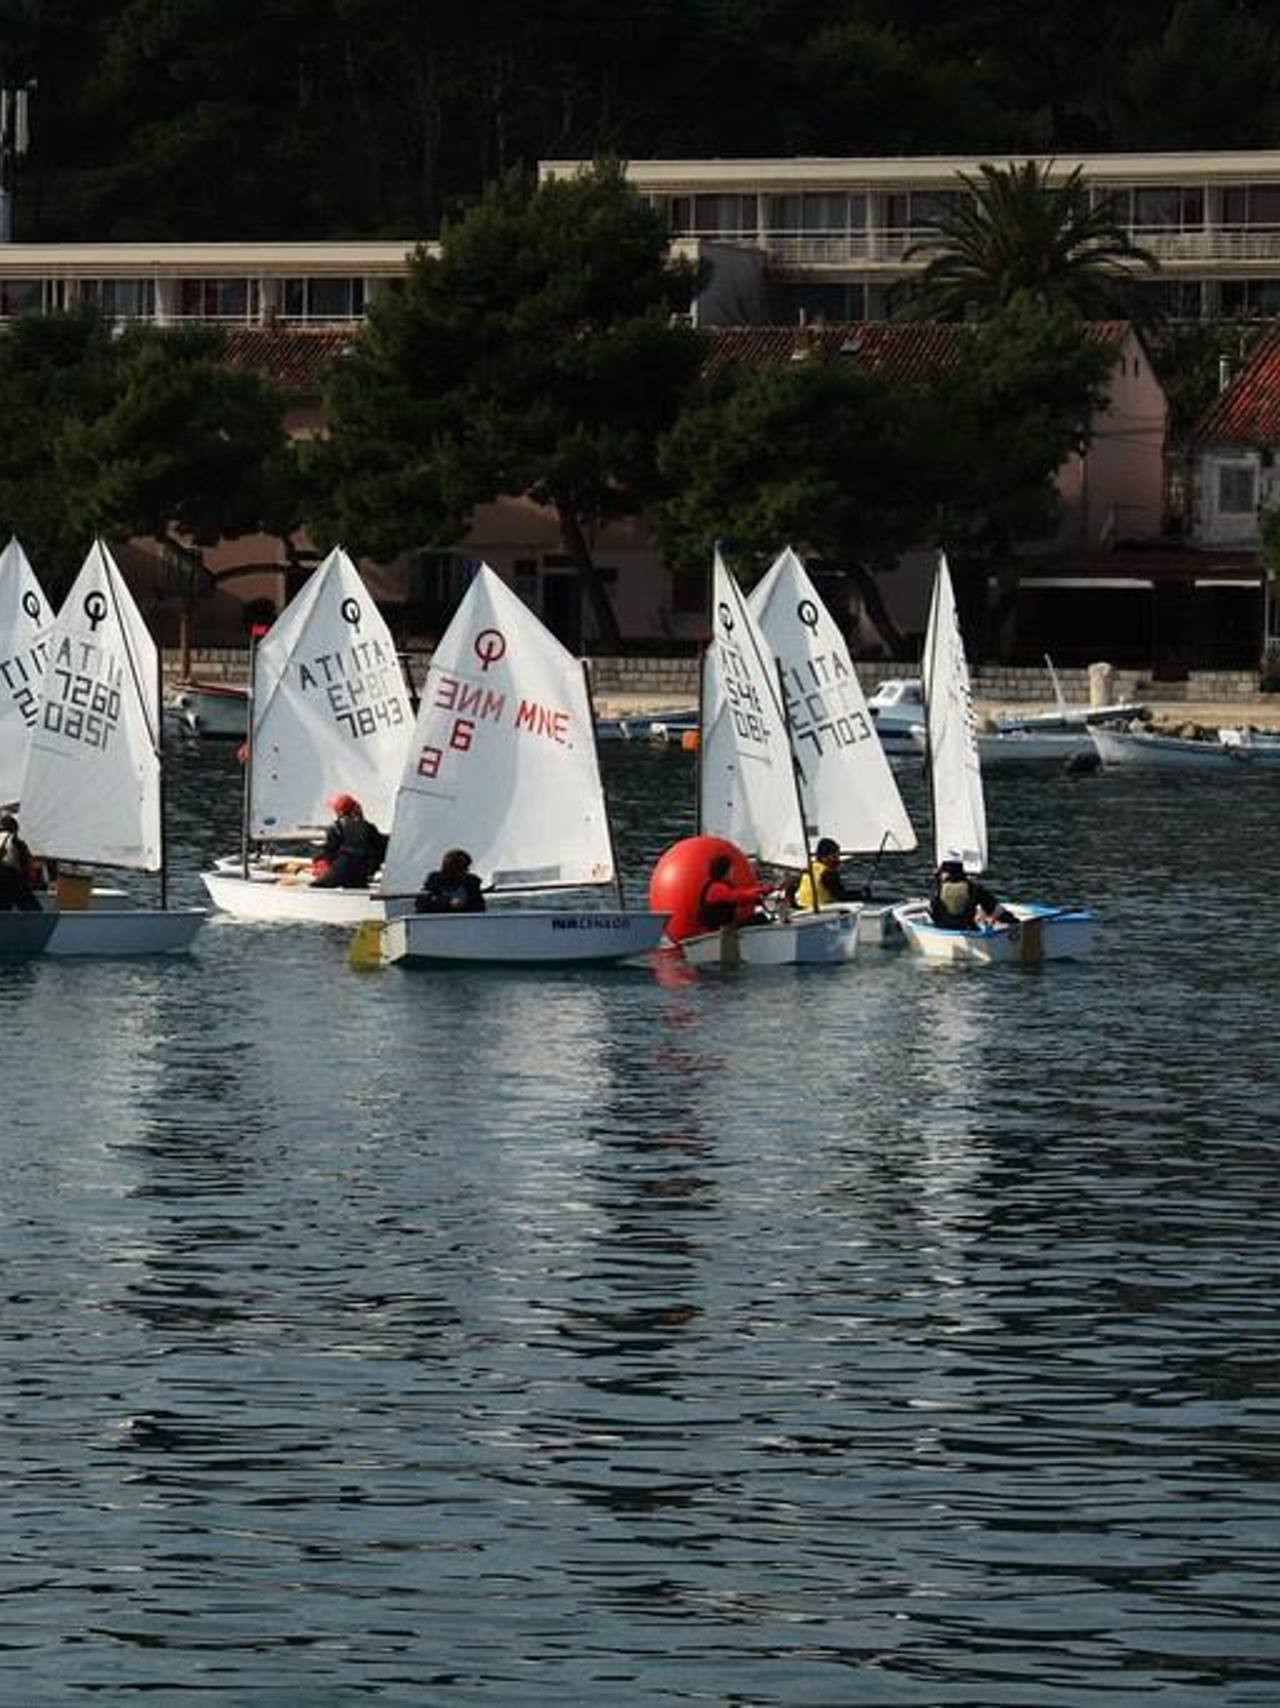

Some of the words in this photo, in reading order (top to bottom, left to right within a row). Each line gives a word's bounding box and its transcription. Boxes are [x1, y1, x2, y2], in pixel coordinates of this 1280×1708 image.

[807, 651, 848, 687] ITA
[54, 667, 122, 722] 7260
[336, 696, 404, 738] 7843
[449, 718, 476, 752] 6
[515, 700, 570, 745] MNE
[798, 713, 871, 756] 7703
